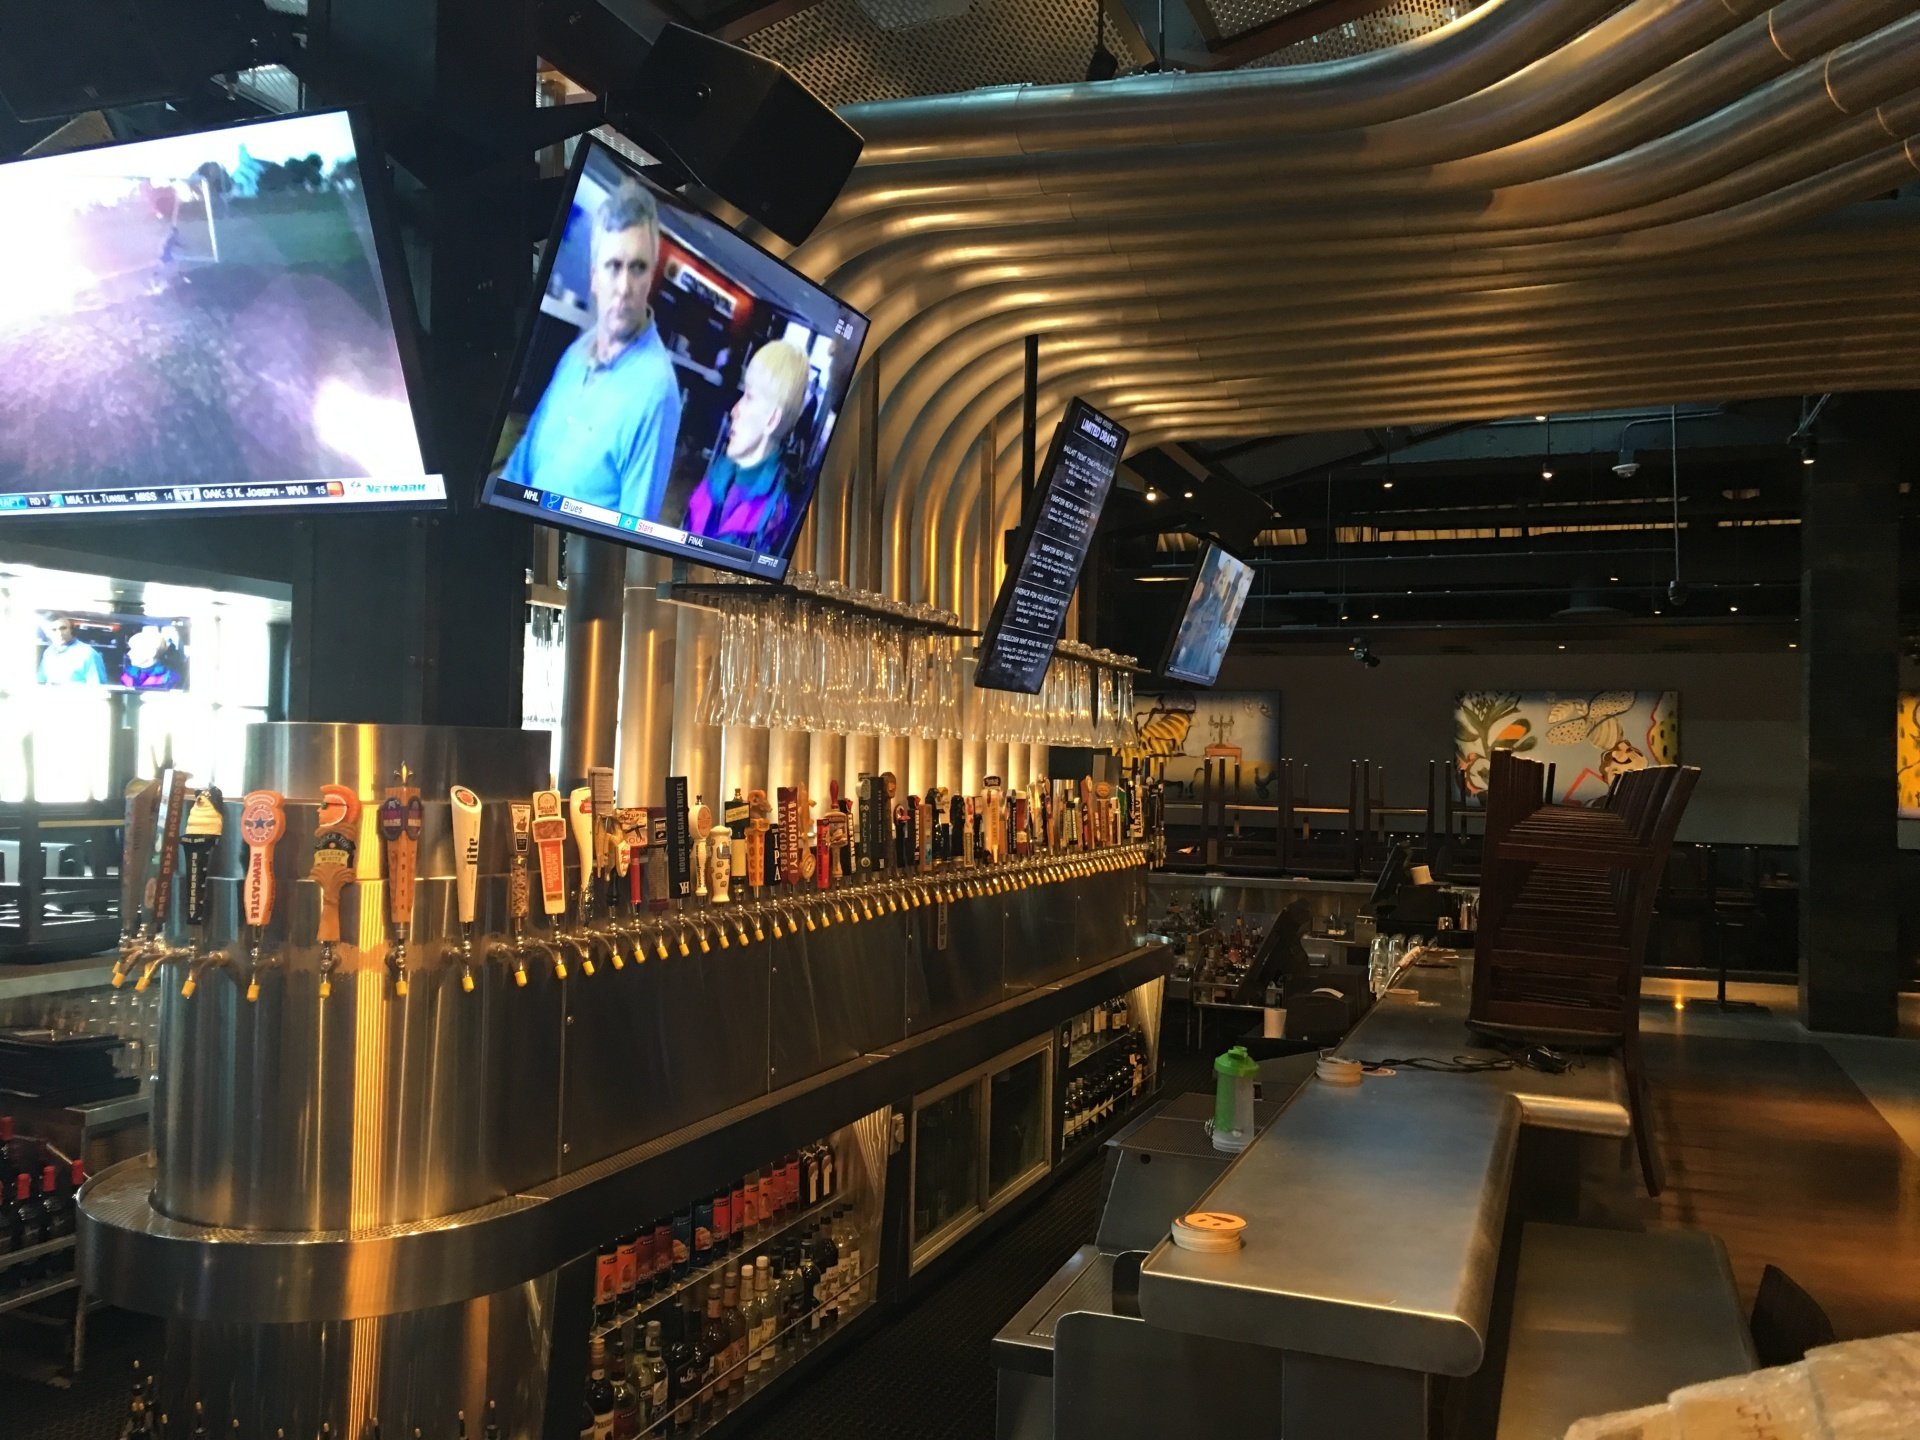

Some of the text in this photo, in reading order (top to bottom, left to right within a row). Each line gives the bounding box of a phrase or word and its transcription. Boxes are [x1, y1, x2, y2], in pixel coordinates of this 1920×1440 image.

[1081, 418, 1118, 448] LIMITED DRAFTS
[29, 497, 41, 505] RD
[65, 495, 83, 504] MIA:
[135, 492, 157, 501] MISS
[163, 492, 173, 501] 14
[203, 489, 225, 499] OAK:
[286, 485, 308, 496] WVU
[316, 486, 326, 495] 15
[524, 490, 538, 502] NHL
[563, 501, 583, 514] Blues
[637, 521, 653, 533] Stars
[680, 533, 686, 542] 2
[688, 535, 703, 548] FINAL
[467, 838, 478, 865] lite
[676, 782, 687, 873] HOUSE BELGIAN TRIPEL
[778, 806, 788, 872] EASTCIDERS
[788, 824, 798, 867] HONEY
[251, 853, 262, 919] NEWCASTLE
